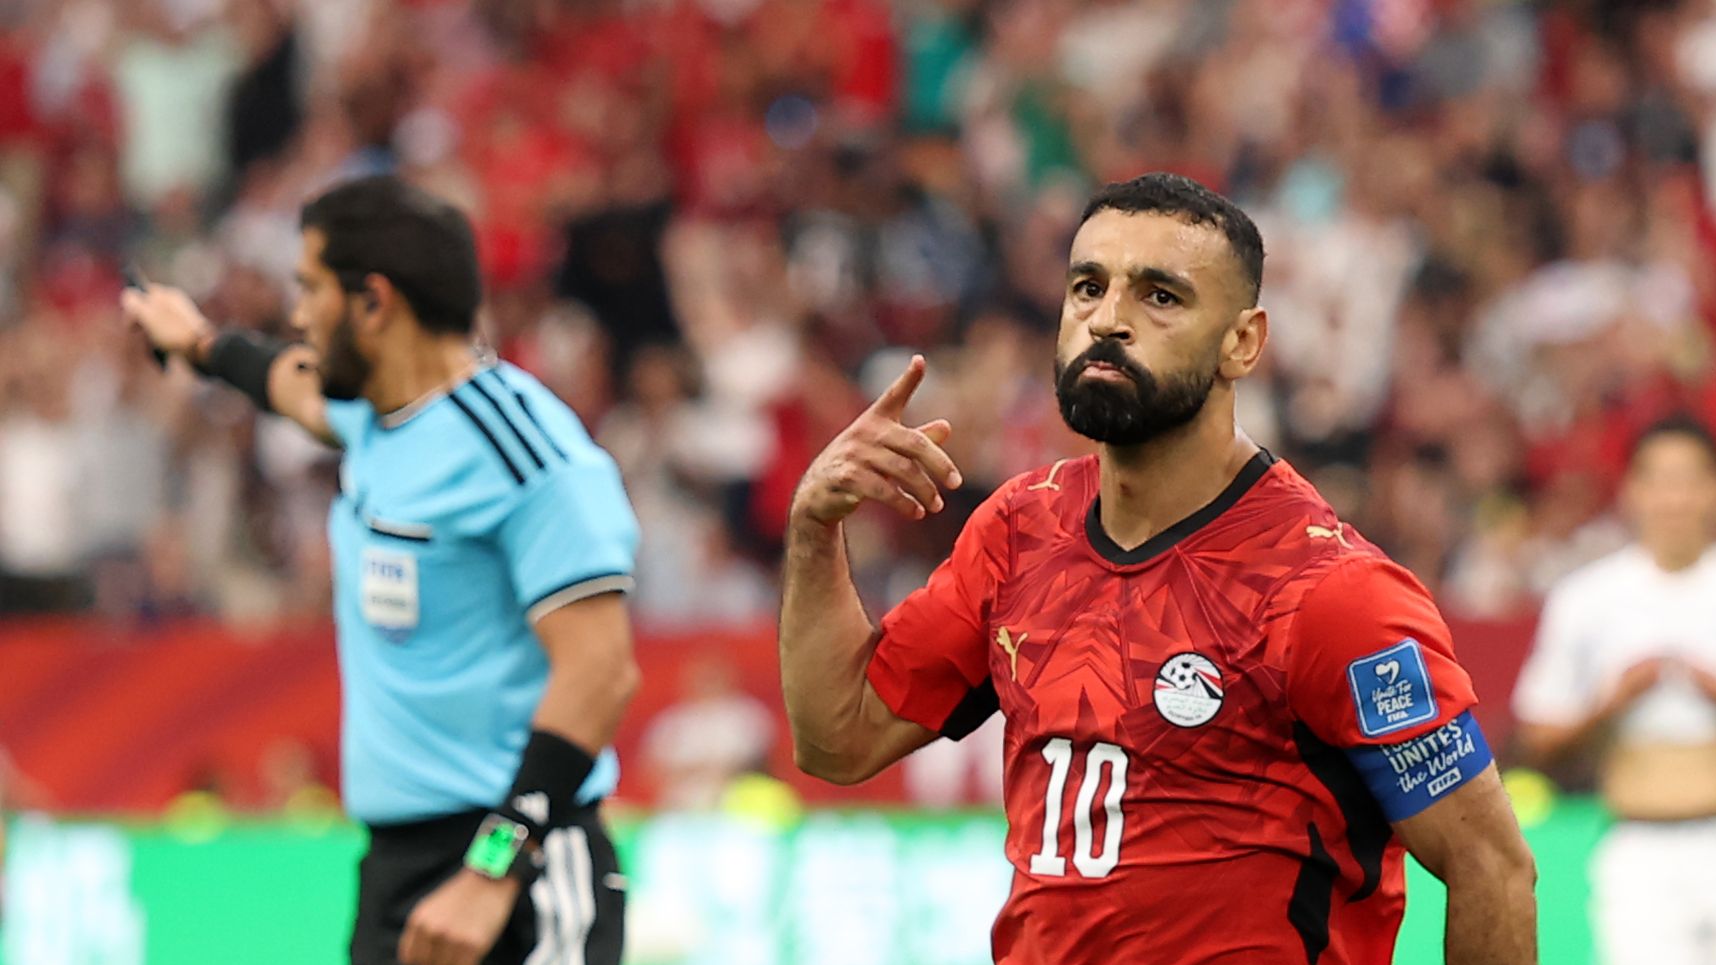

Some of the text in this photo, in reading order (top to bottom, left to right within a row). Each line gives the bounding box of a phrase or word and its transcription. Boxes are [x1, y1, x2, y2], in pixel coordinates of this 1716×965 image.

[1377, 693, 1414, 716] PEACE
[1387, 710, 1409, 723] FIFA
[1388, 719, 1462, 775] UNITES
[1397, 772, 1428, 793] the
[1426, 732, 1475, 777] World
[1429, 769, 1460, 795] FIFA
[1029, 737, 1129, 878] 10
